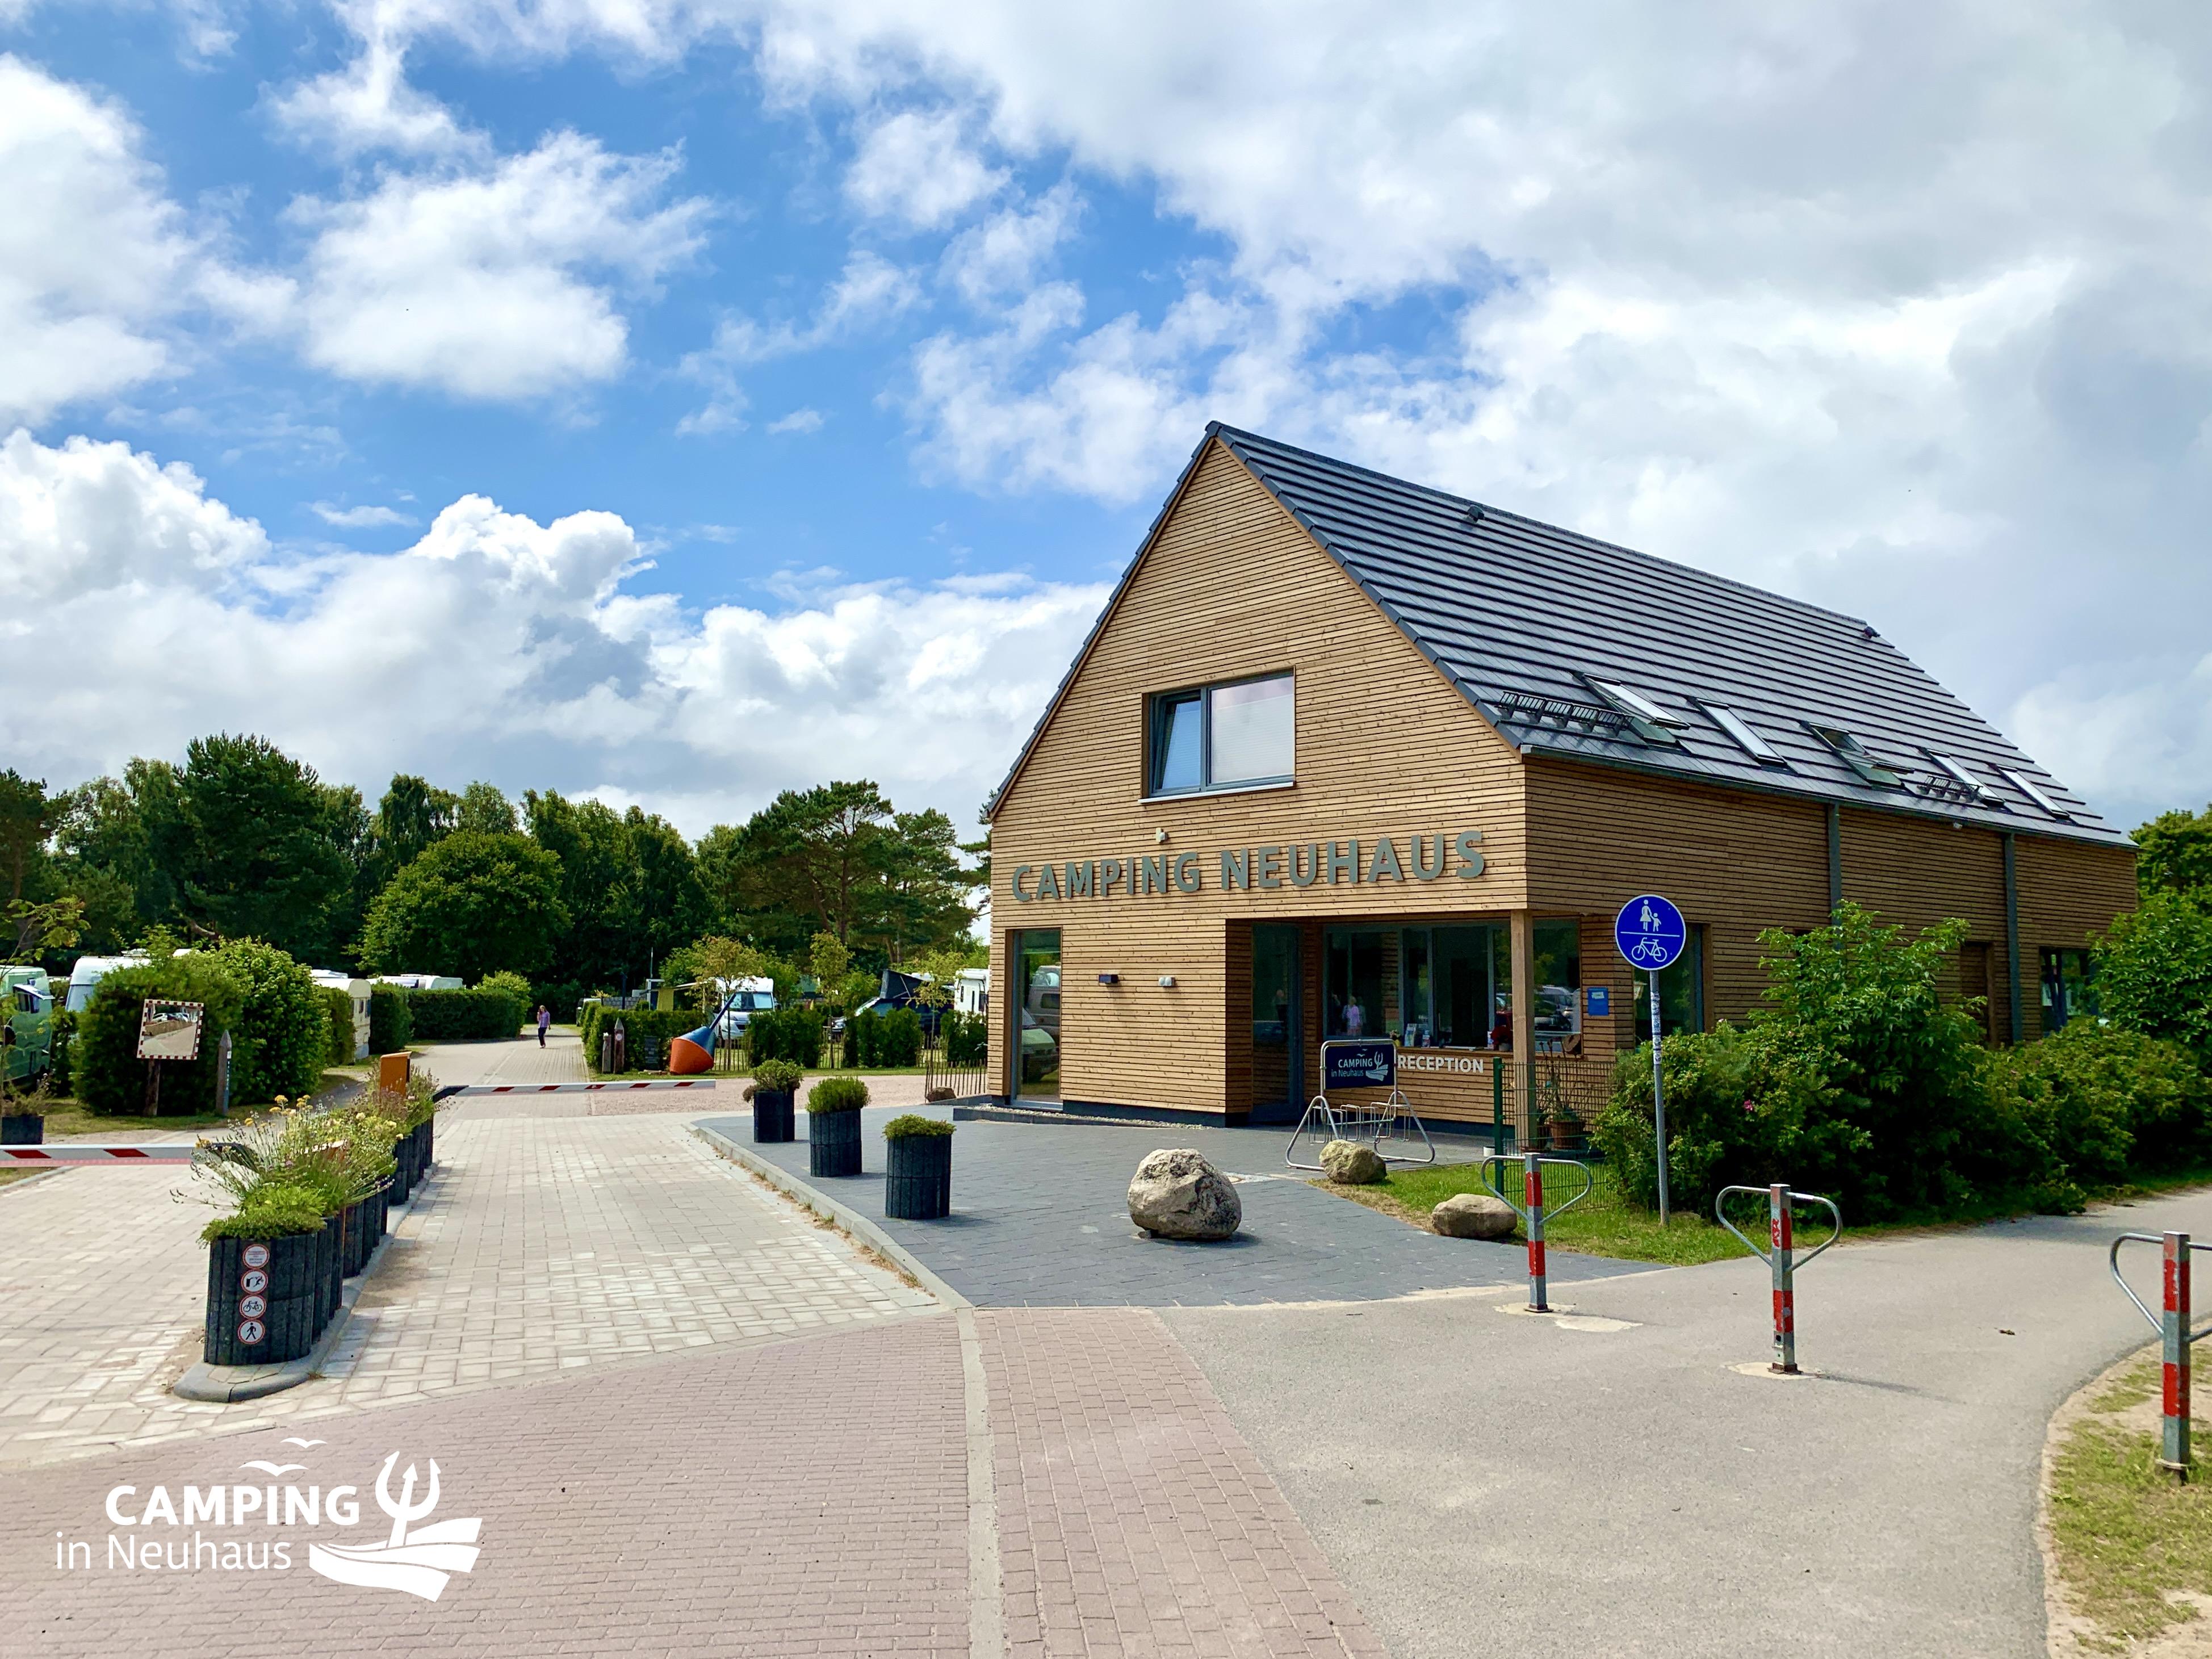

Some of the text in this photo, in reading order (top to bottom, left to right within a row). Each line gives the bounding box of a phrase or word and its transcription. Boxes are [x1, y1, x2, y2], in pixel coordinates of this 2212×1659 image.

[1012, 829, 1485, 902] CAMPING NEUHAUS
[1338, 1058, 1373, 1068] CAMPING
[1397, 1054, 1484, 1074] RECEPTION
[1331, 1068, 1364, 1077] in Neuhaus
